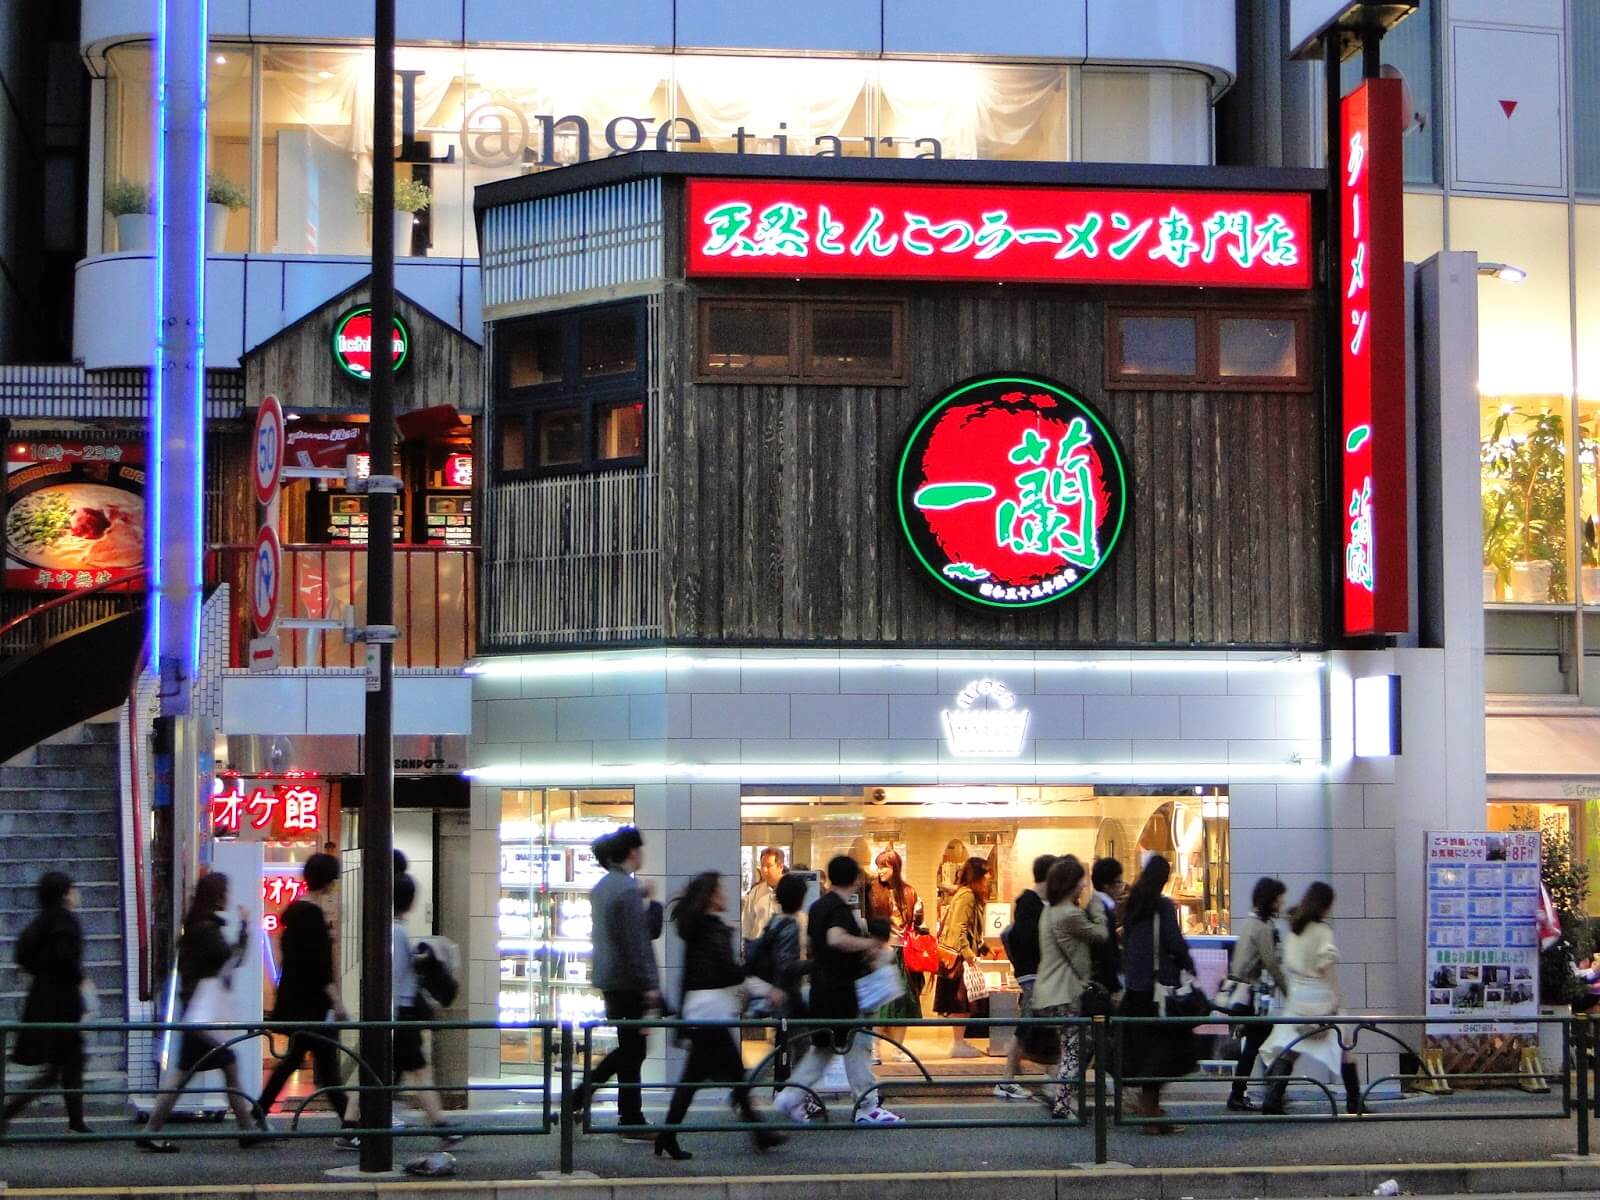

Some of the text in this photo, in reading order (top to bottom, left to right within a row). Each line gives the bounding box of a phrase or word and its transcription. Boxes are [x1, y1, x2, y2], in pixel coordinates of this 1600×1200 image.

[733, 122, 942, 160] tiara
[703, 200, 1299, 268] 天然とんこつラーメン専門店
[1346, 132, 1375, 592] ラーメン 一蘭
[260, 425, 276, 473] 50
[914, 416, 1100, 569] 一蘭
[34, 569, 113, 589] 年中無休
[994, 916, 1002, 929] 6
